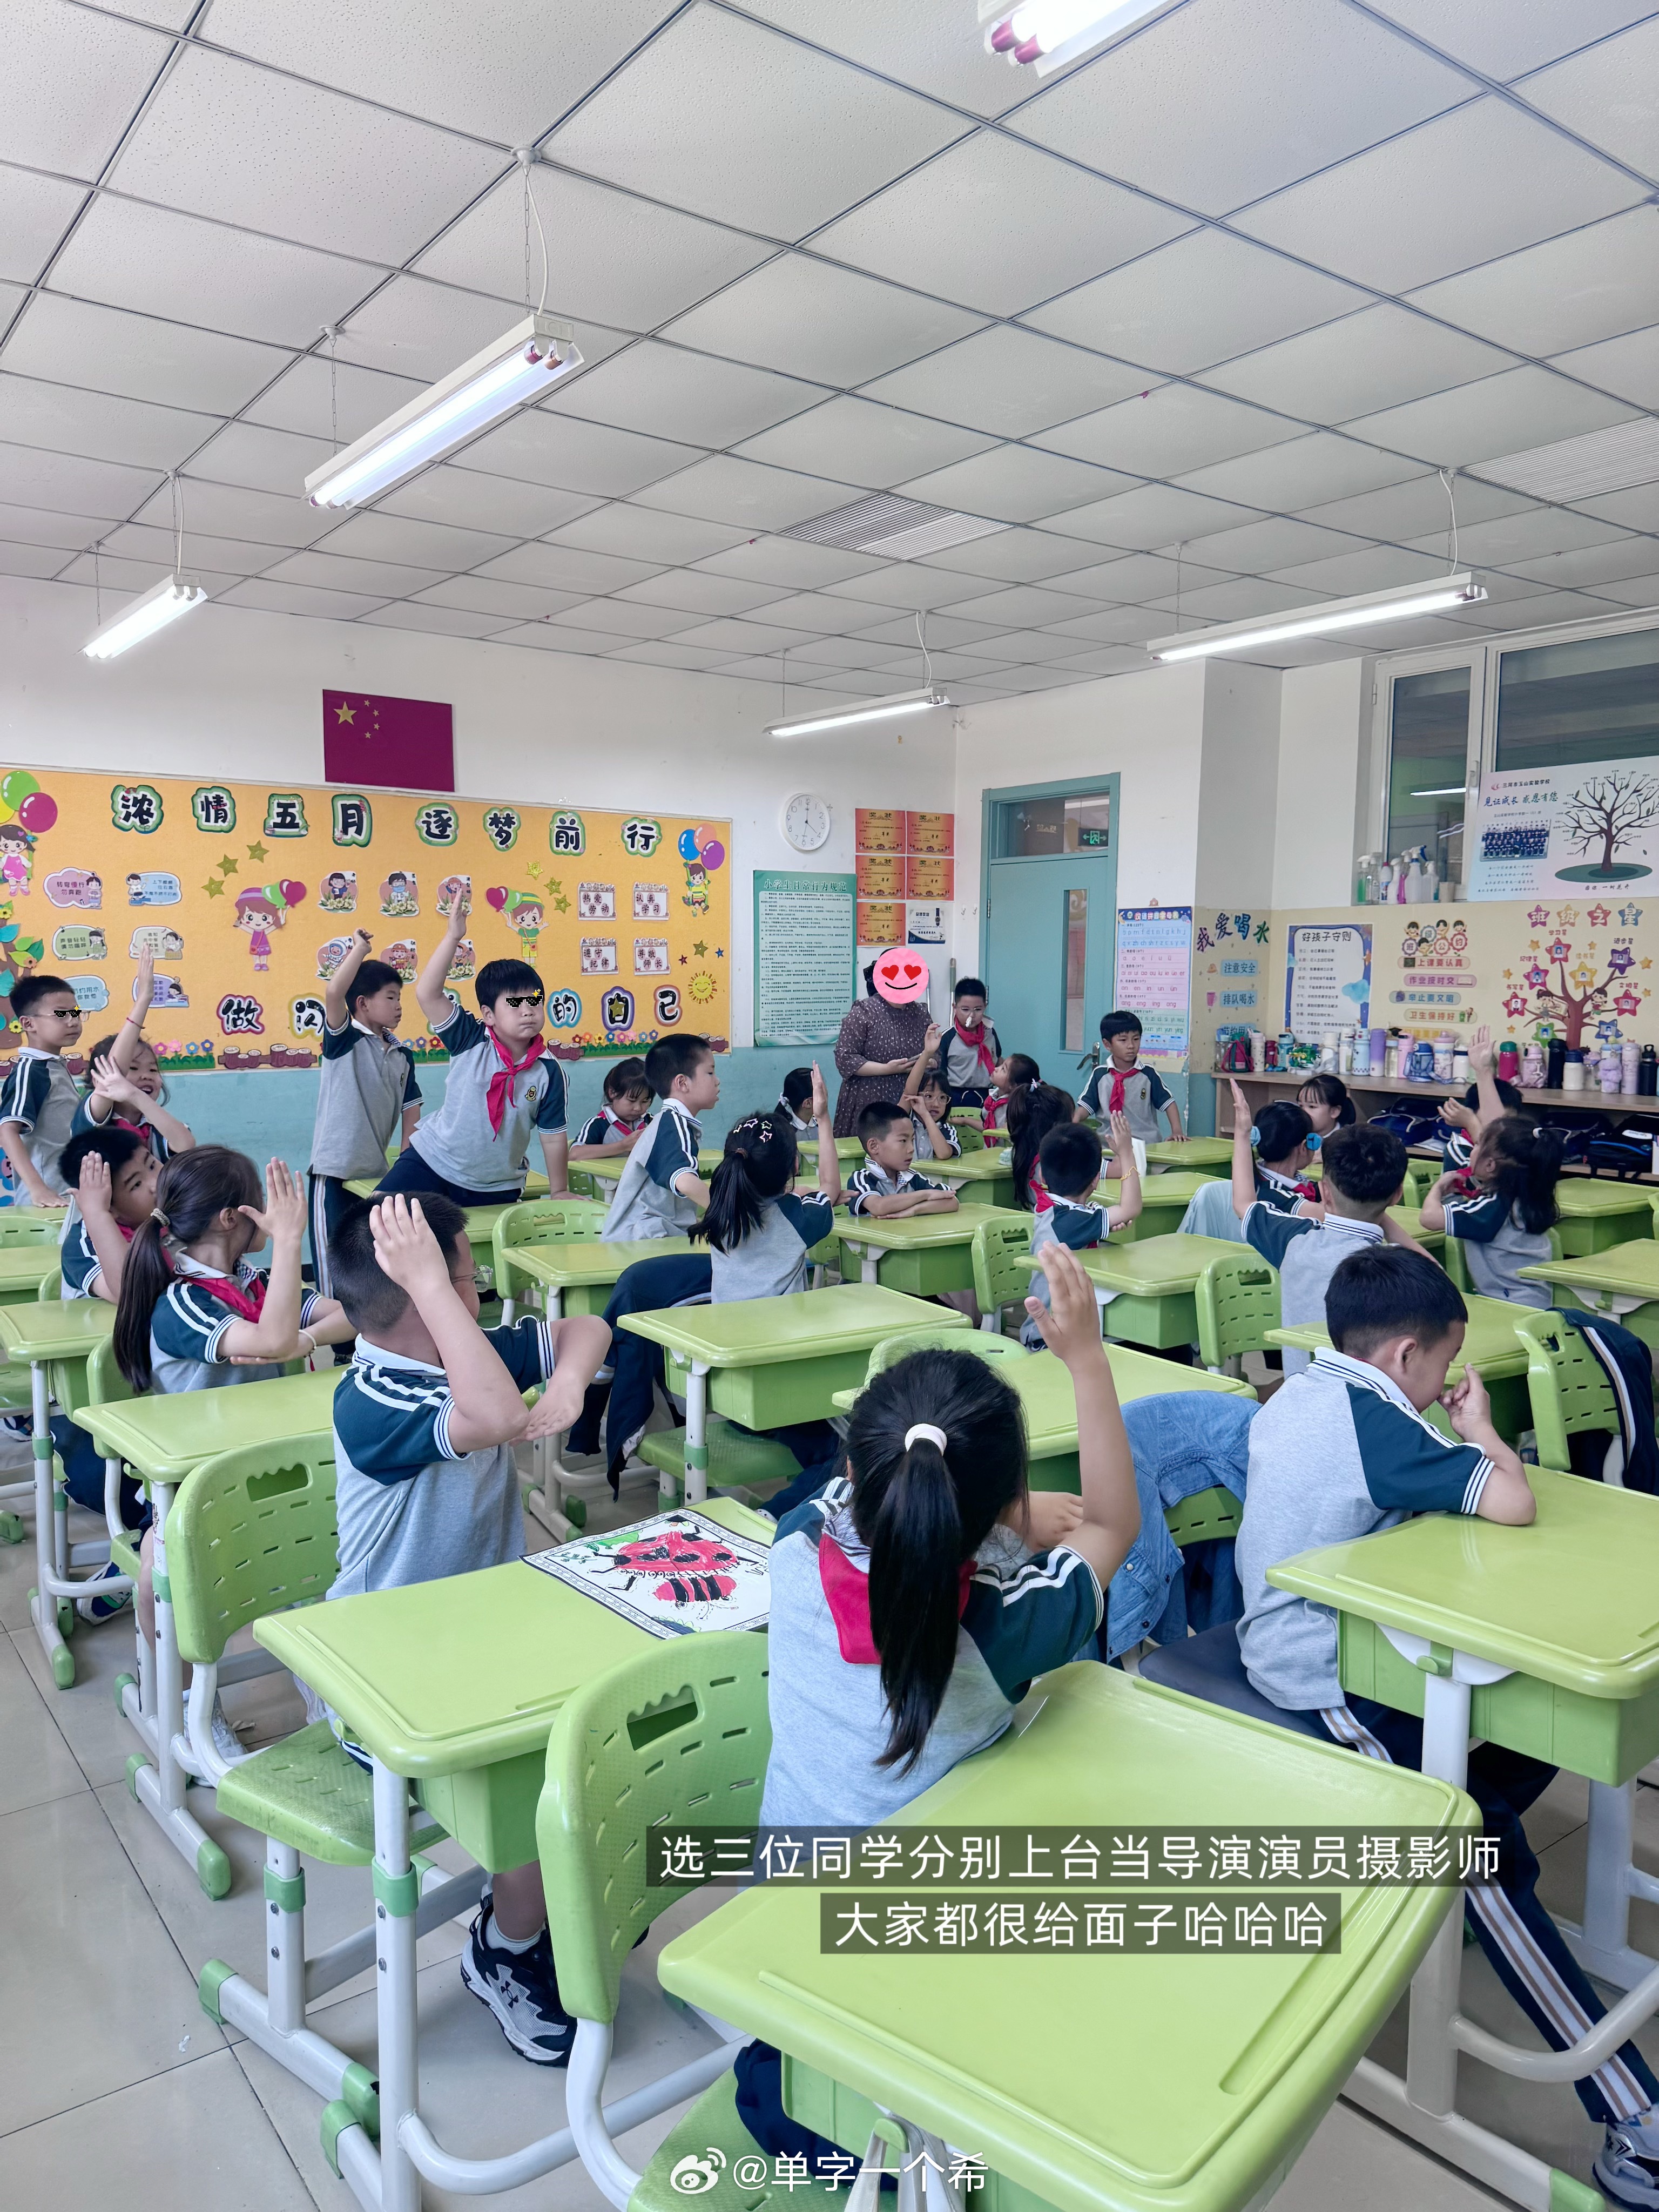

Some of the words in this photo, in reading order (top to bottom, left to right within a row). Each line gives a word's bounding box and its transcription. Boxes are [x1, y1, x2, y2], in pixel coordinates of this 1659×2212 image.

[1483, 795, 1519, 807] 见证成长
[1522, 791, 1558, 804] 感恩有您
[120, 793, 365, 837] 浓情五月
[422, 810, 655, 852] 逐梦前行
[764, 879, 847, 891] 小学生日常行为规范
[583, 894, 602, 903] 热爱
[636, 894, 655, 903] 认真
[589, 904, 609, 914] 劳动
[642, 905, 659, 913] 学习
[1531, 907, 1636, 924] 班级之星
[1197, 913, 1270, 952] 我爱喝水
[1302, 931, 1351, 942] 好孩子守则
[584, 948, 602, 957] 遵守
[638, 949, 656, 958] 尊敬
[590, 958, 609, 967] 纪律
[643, 960, 662, 968] 师长
[1418, 959, 1463, 967] 上课要认真
[1224, 962, 1256, 974] 注意安全
[1409, 976, 1454, 984] 作业按时交
[1223, 994, 1255, 1005] 排队喝水
[1408, 994, 1454, 1002] 举止要文明
[1409, 1011, 1455, 1021] 卫生保持好
